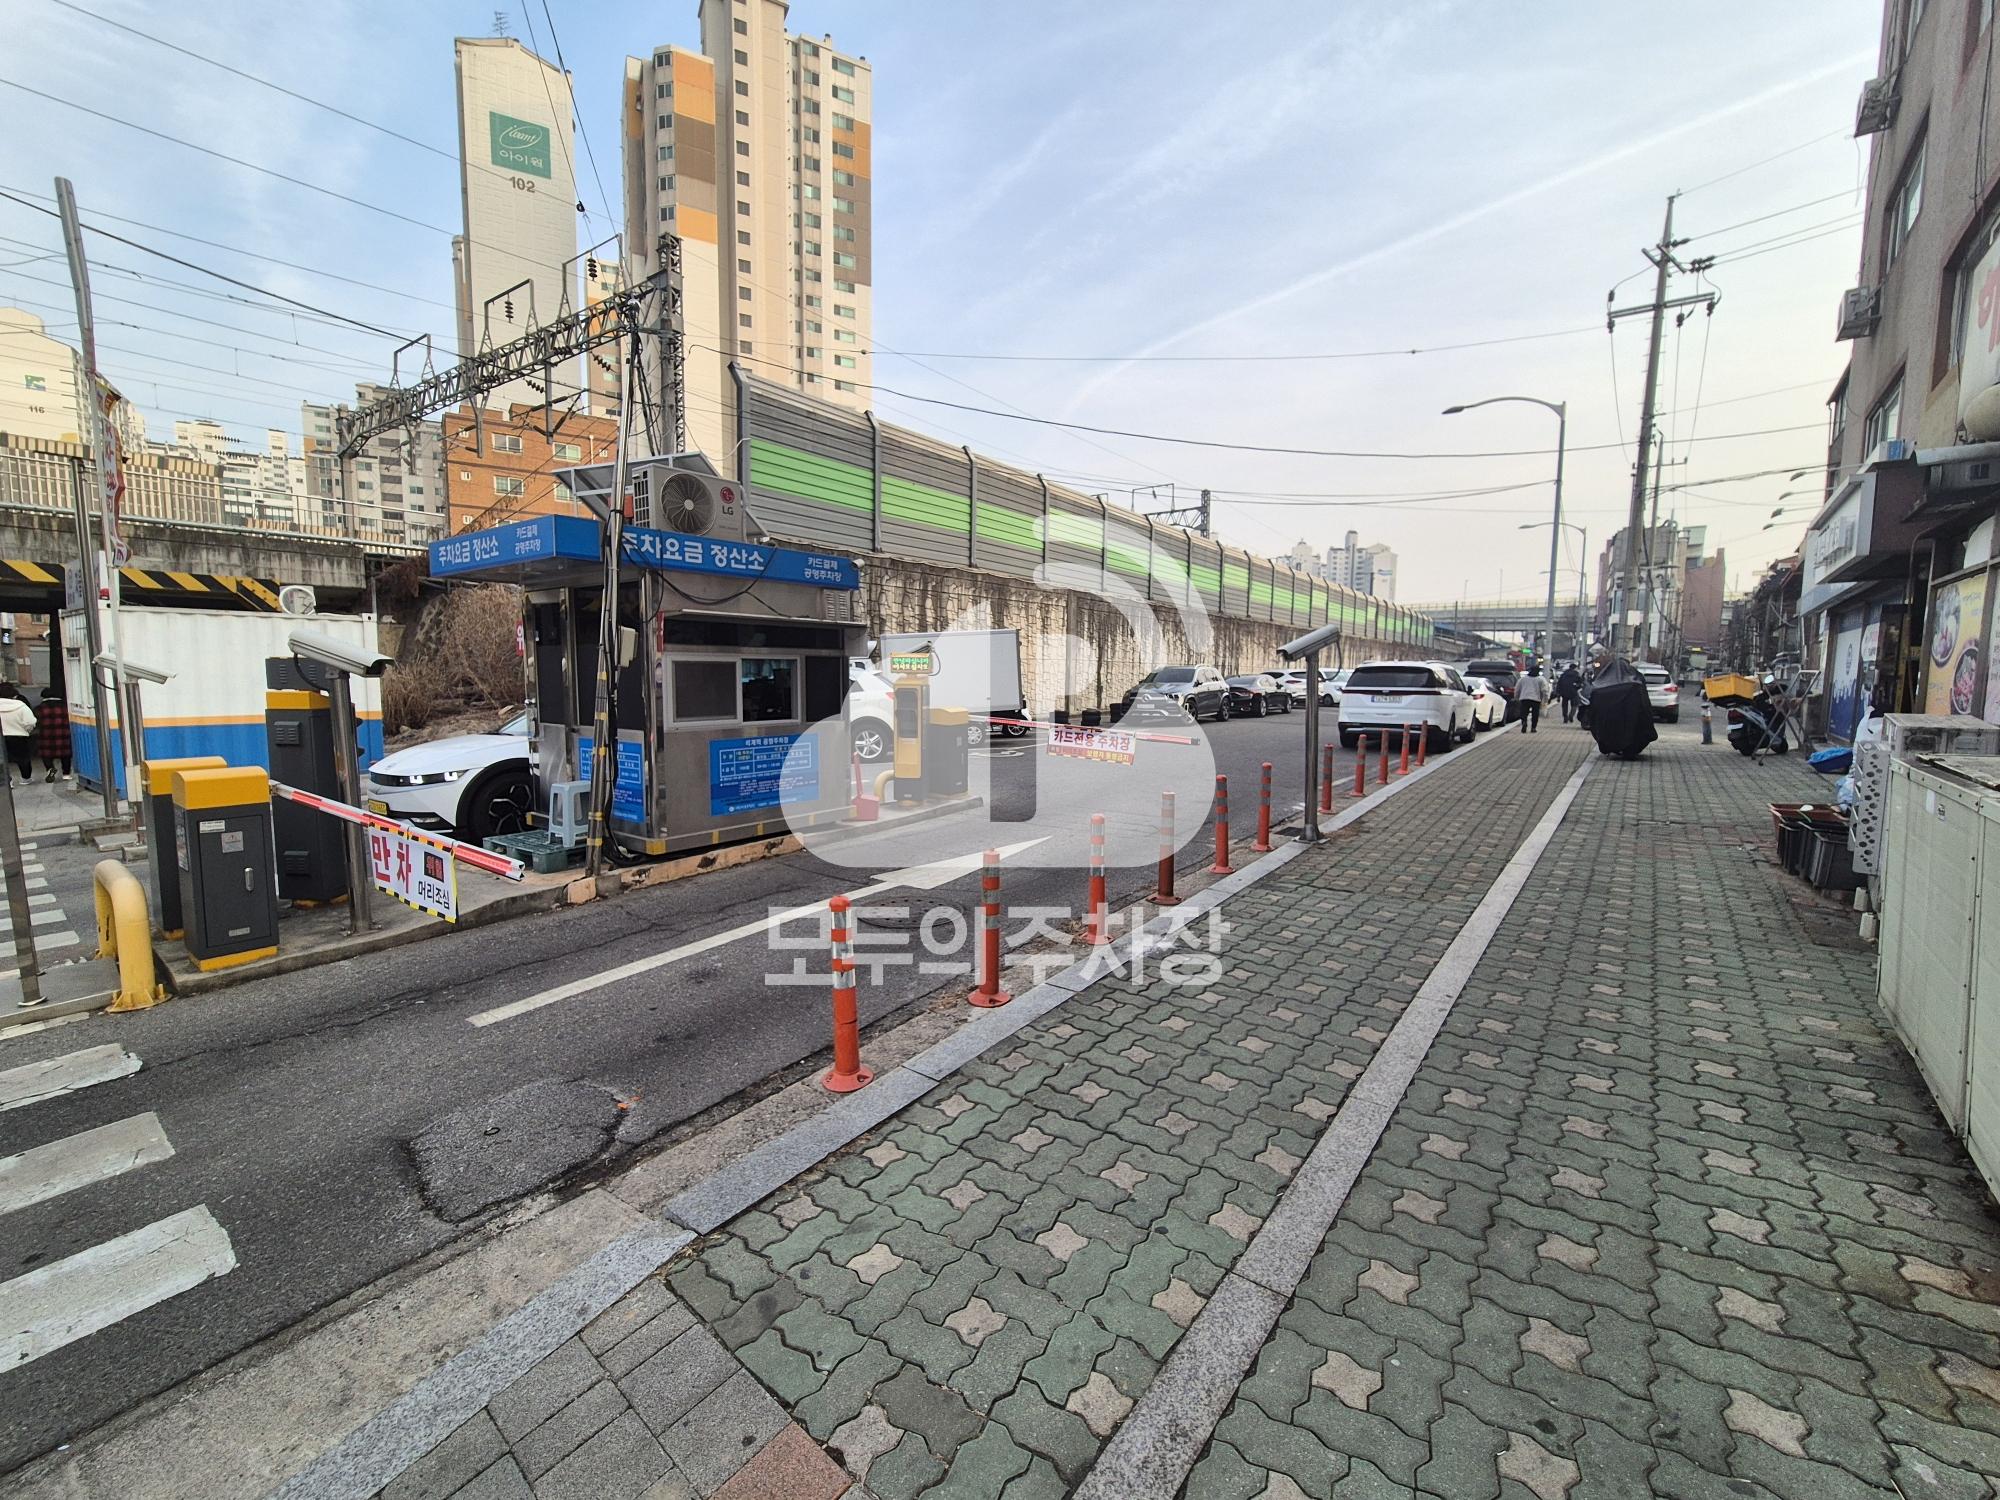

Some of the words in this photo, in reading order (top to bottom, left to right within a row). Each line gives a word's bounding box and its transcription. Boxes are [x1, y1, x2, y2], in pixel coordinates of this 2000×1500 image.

[499, 149, 544, 169] 아이원
[509, 176, 536, 194] 102
[28, 405, 45, 414] 116
[722, 505, 734, 516] LG
[438, 540, 471, 567] 주차요금
[472, 535, 500, 561] 정산소
[622, 531, 703, 564] 주차요금
[710, 544, 765, 571] 정산소
[807, 556, 838, 569] 카드결제
[804, 568, 842, 582] 공영주차장
[1054, 730, 1094, 747] 카드전용
[1097, 735, 1130, 751] 주차장
[418, 881, 450, 910] 머리조심
